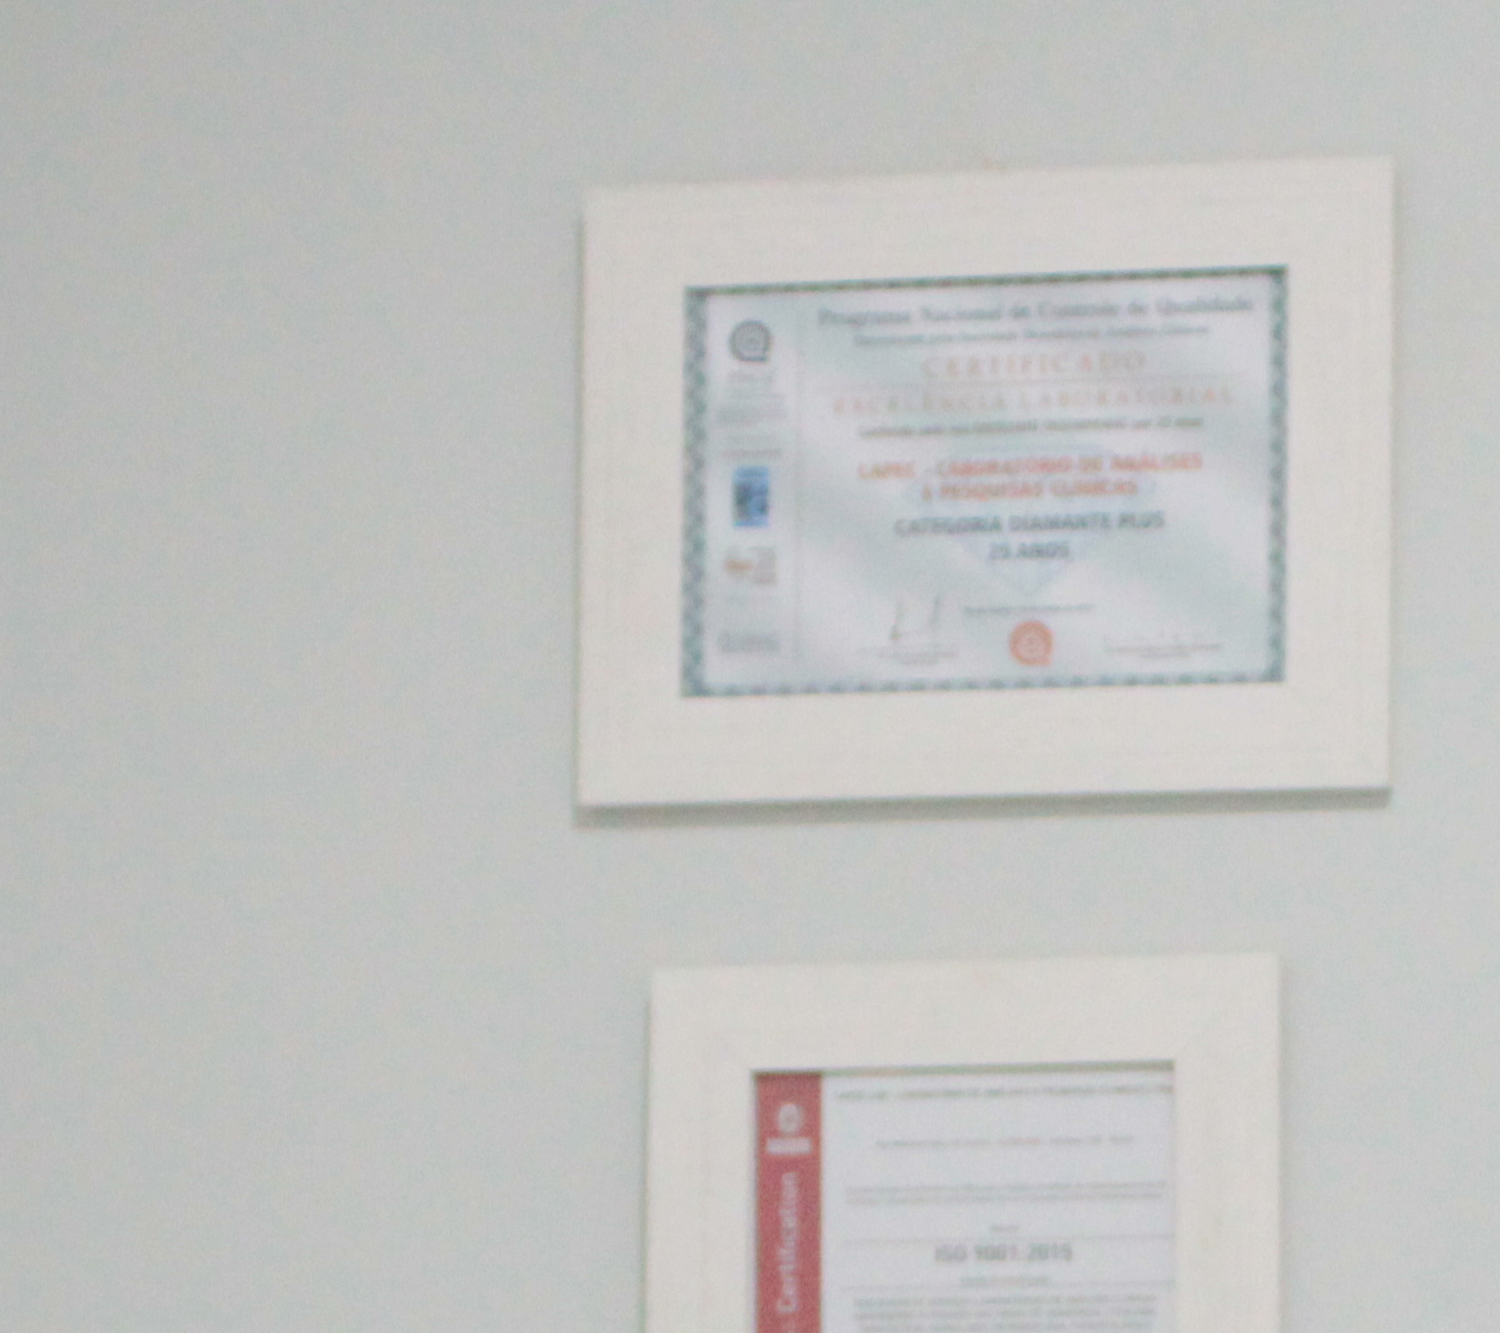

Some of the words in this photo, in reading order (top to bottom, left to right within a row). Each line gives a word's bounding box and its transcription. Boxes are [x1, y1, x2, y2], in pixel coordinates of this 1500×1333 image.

[893, 514, 1002, 538] CATEGORIA
[1008, 511, 1112, 533] DIAMANTE
[1118, 510, 1166, 530] PLUS
[1015, 540, 1070, 559] ANOS
[775, 1171, 799, 1315] Certification
[934, 1243, 968, 1263] ISO
